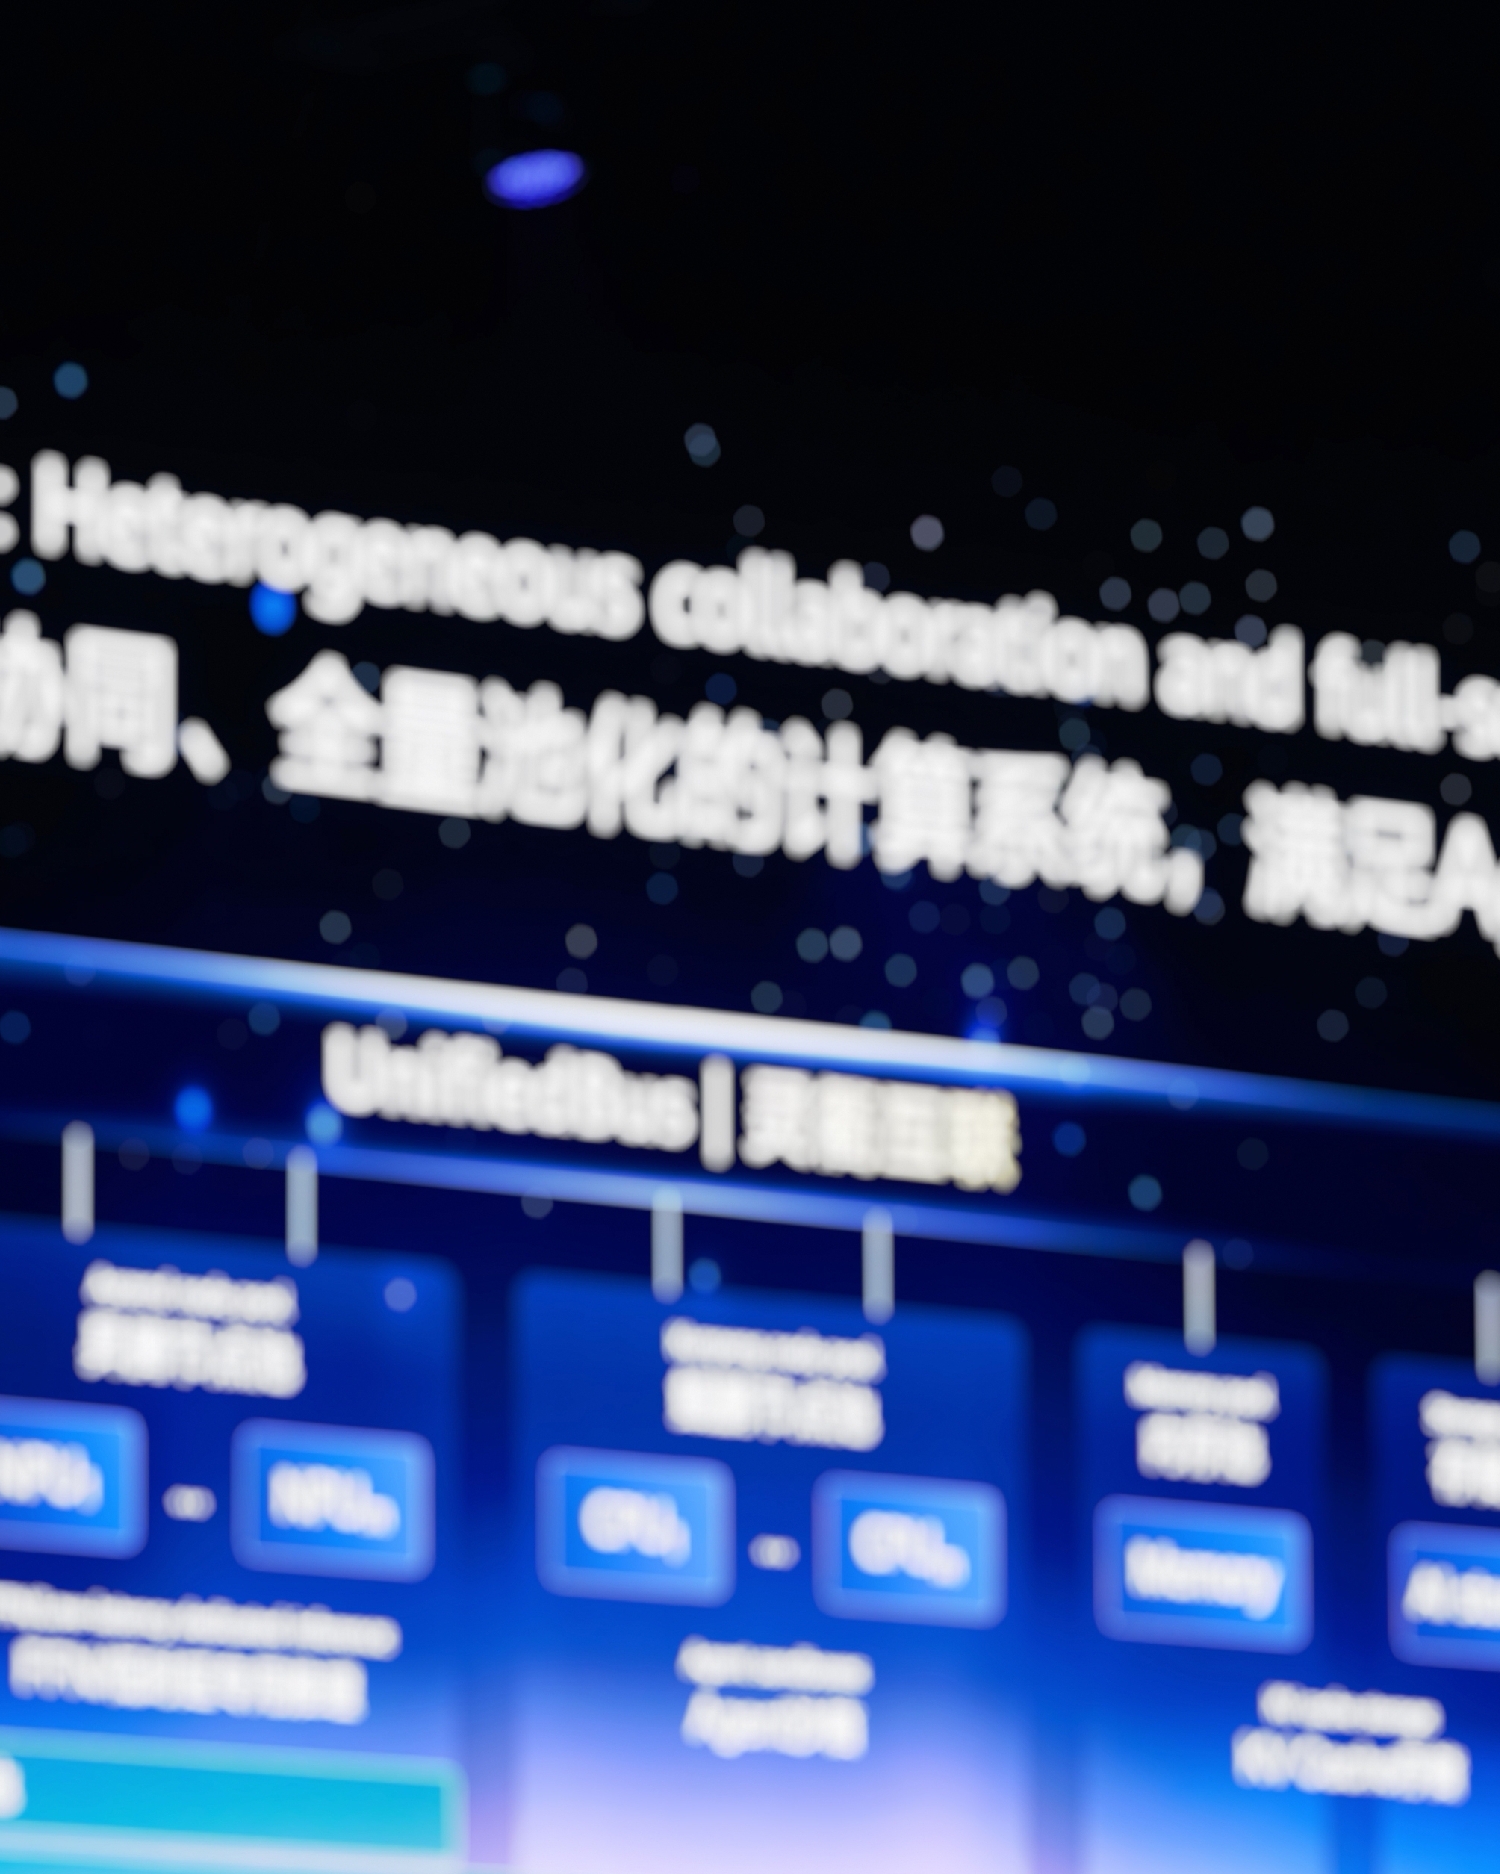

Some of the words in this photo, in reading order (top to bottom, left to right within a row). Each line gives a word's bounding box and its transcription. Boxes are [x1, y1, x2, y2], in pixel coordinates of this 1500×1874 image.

[32, 453, 643, 639] Heterogeneous
[650, 550, 1148, 708] collaboration
[1155, 627, 1303, 730] and
[322, 1023, 697, 1150] UnifiedBus
